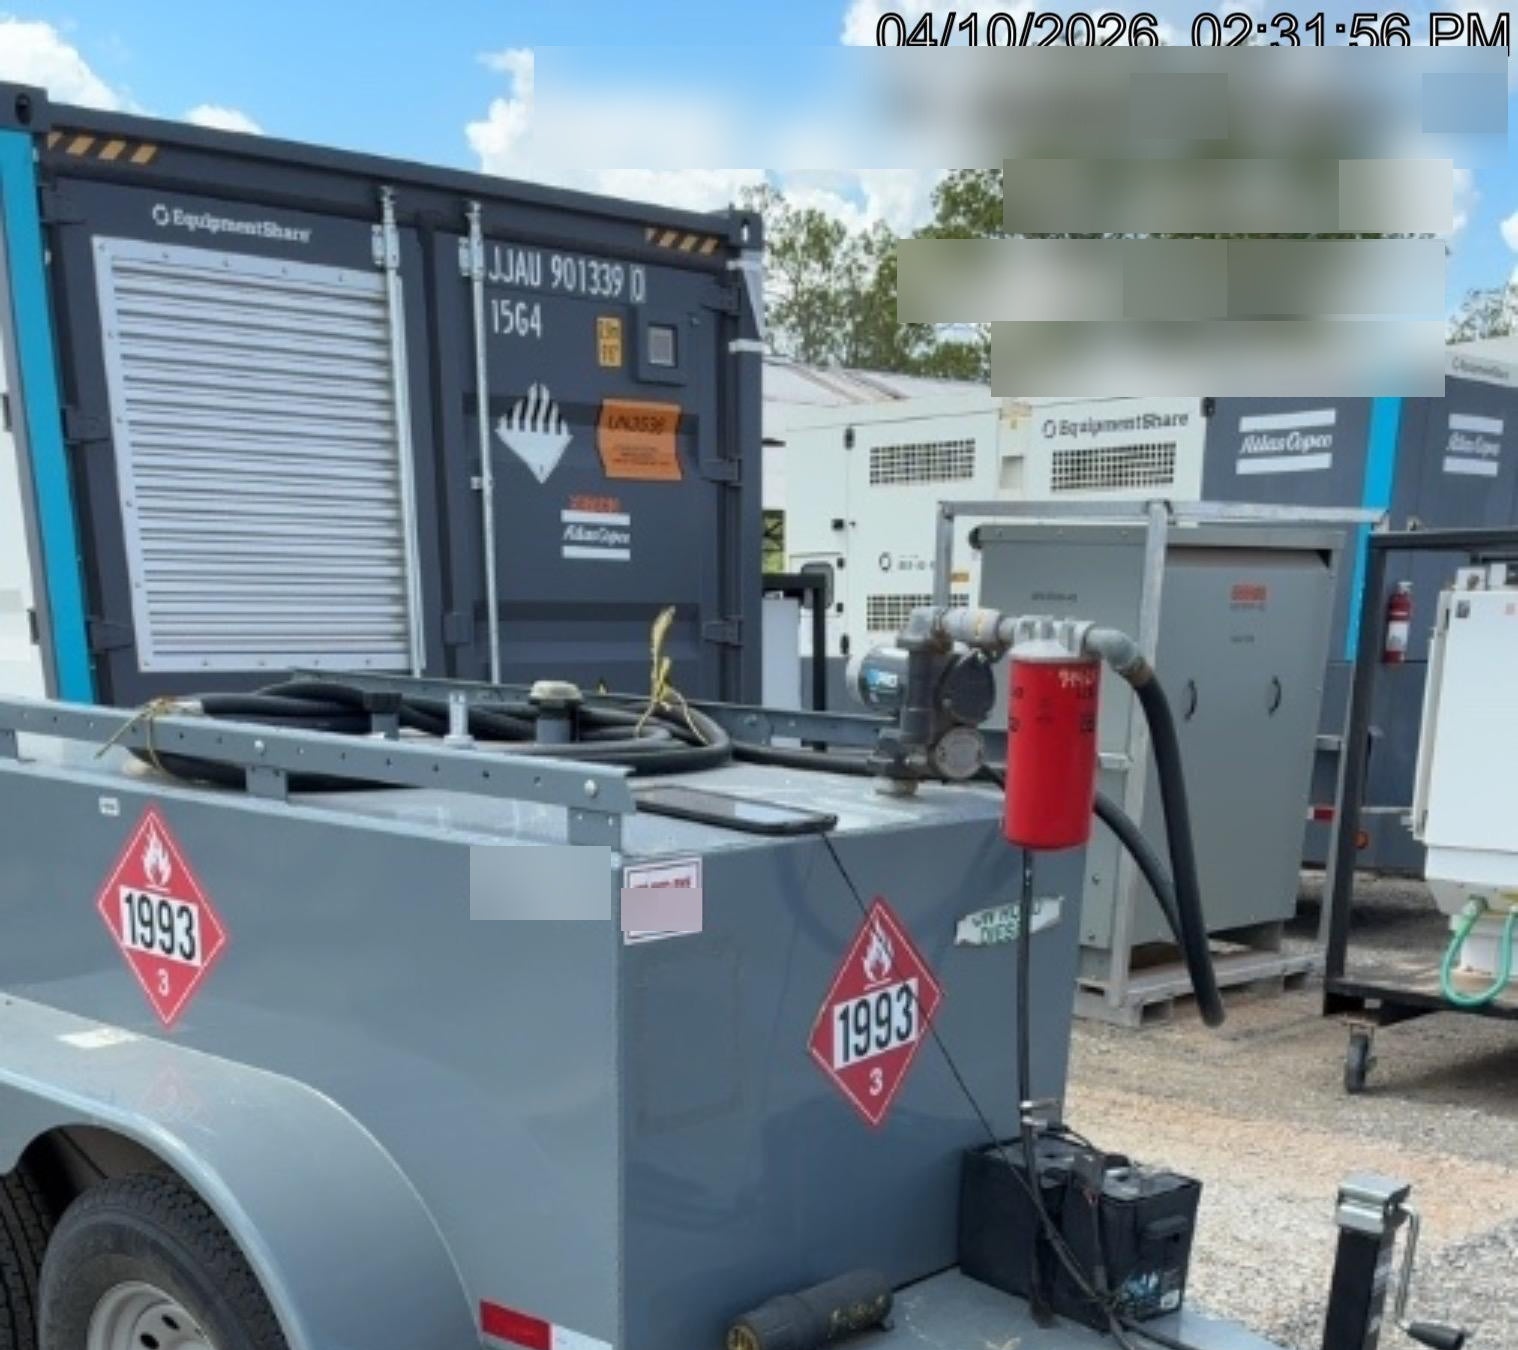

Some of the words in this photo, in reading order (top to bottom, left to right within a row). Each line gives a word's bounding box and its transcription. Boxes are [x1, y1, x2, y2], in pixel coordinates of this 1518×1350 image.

[172, 208, 312, 243] EquipmentShare
[487, 245, 541, 287] JJAU
[551, 254, 624, 298] 901339
[491, 299, 541, 339] 15G4
[1058, 412, 1189, 438] EquipmentShare
[125, 892, 195, 961] 1993
[157, 967, 170, 997] 3
[839, 983, 914, 1062] 1993
[868, 1066, 884, 1096] 3
